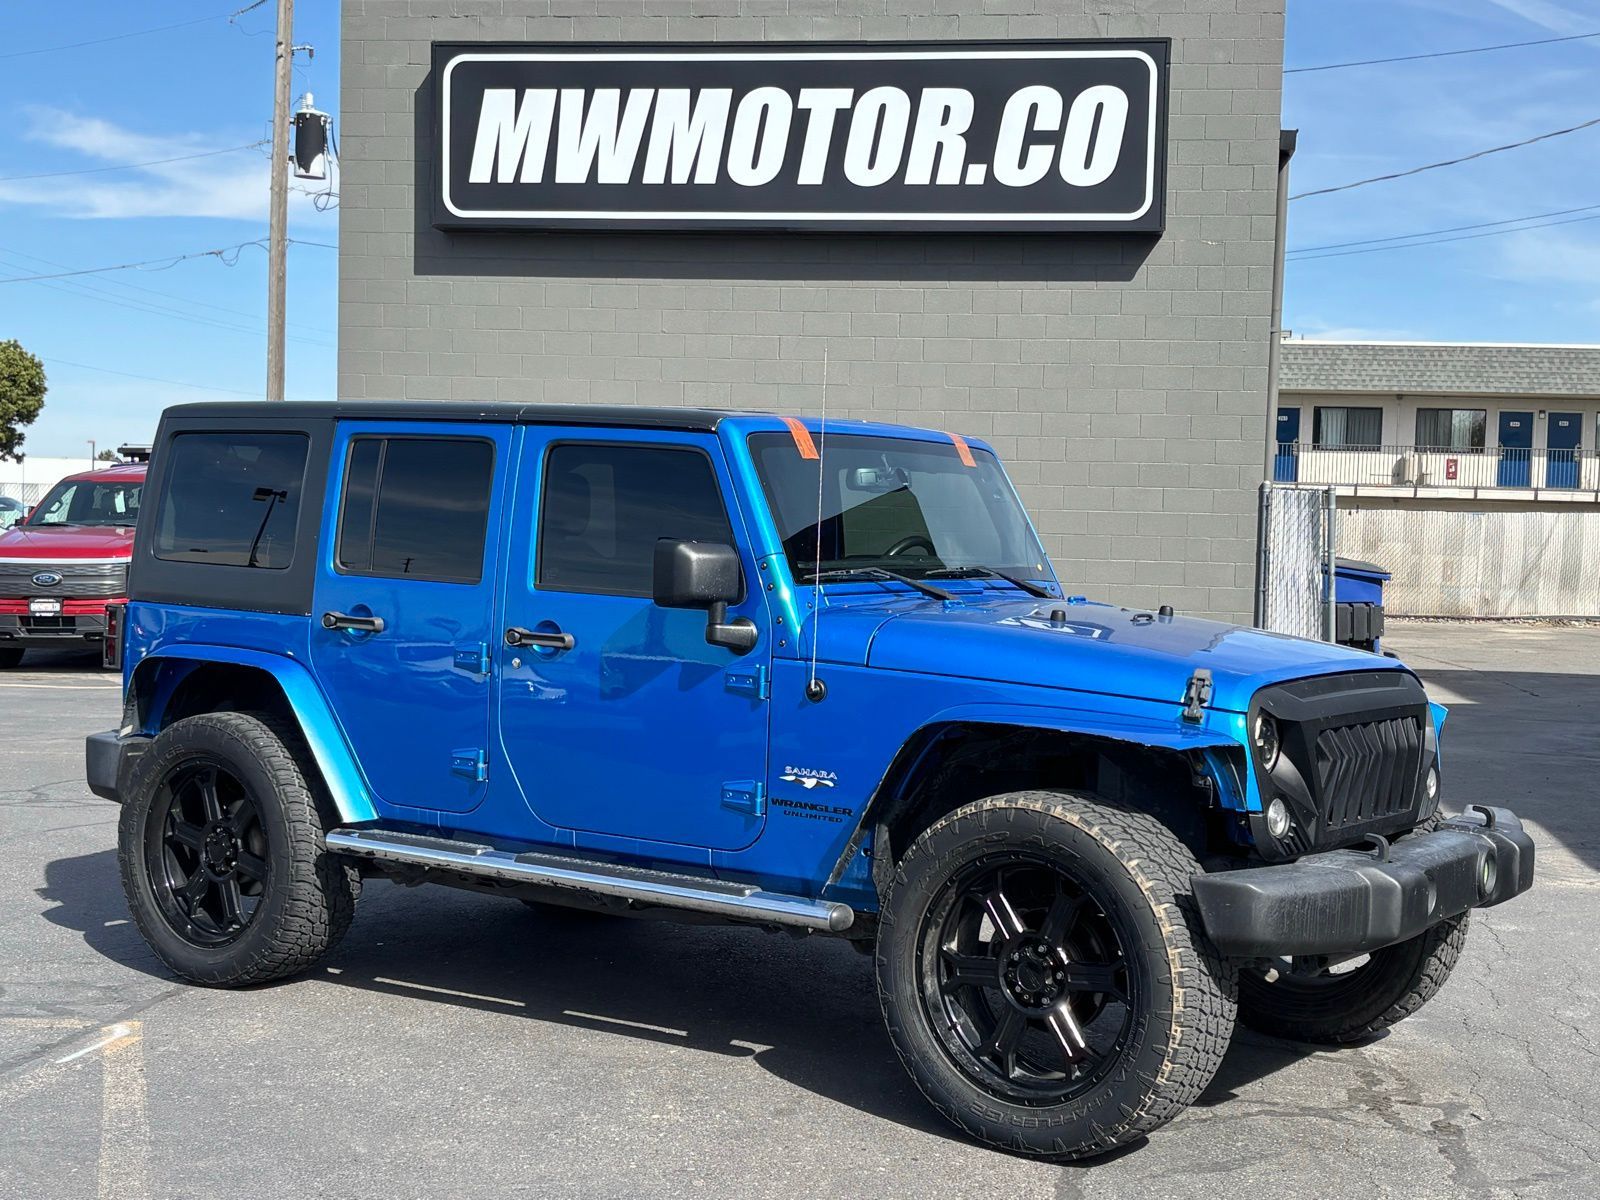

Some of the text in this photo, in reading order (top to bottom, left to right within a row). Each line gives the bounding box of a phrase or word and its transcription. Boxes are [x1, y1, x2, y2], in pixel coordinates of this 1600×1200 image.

[468, 84, 1129, 188] MWMOTOR.CO
[784, 765, 838, 780] SAHARA
[771, 798, 853, 816] WRANGLER
[783, 809, 843, 823] UNLIMITED
